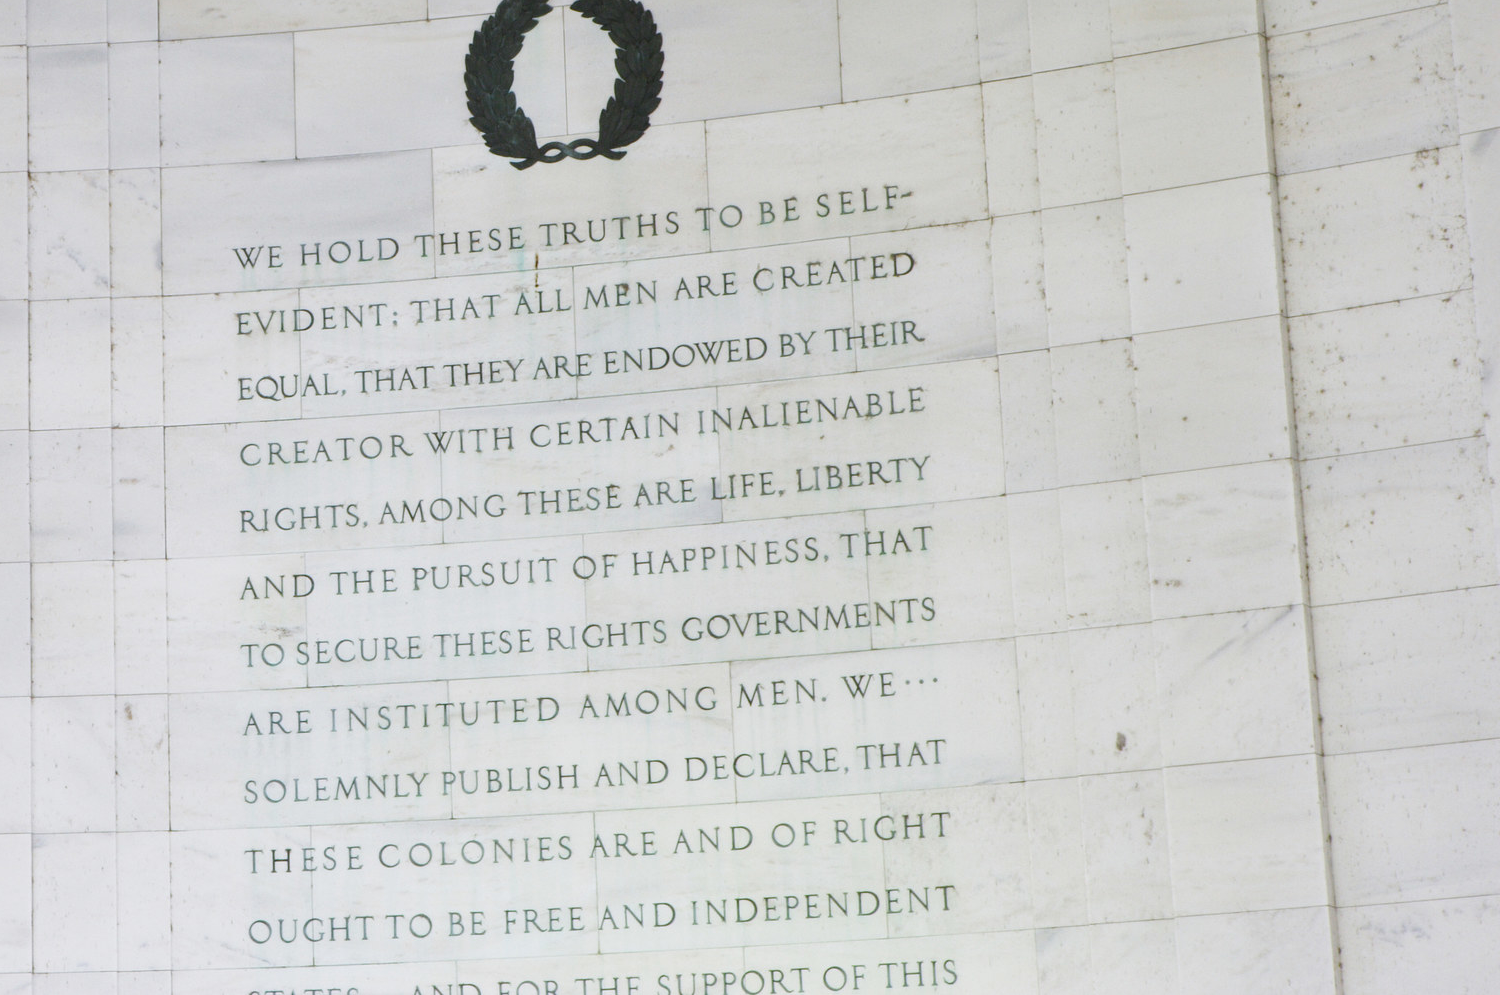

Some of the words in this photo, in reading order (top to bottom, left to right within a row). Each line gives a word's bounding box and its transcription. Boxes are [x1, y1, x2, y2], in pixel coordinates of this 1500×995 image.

[232, 245, 283, 269] WE
[300, 238, 399, 266] HOLD
[414, 226, 525, 257] THESE
[539, 211, 679, 246] TRUTHS
[695, 205, 743, 234] TO
[758, 199, 800, 225] BE
[816, 184, 914, 218] SELF-
[234, 303, 398, 336] EVIDENT;
[409, 294, 501, 325] THAT
[514, 287, 572, 316] ALL
[583, 280, 657, 310] MEN
[674, 272, 738, 301] ARE
[753, 252, 917, 294] CREATED
[238, 371, 346, 401] EQUAL,
[354, 366, 435, 395] THAT
[443, 359, 521, 387] THEY
[533, 353, 593, 381] ARE
[604, 337, 767, 374] ENDOWED
[779, 331, 817, 357] BY
[824, 321, 925, 352] THEIR
[240, 432, 414, 466] CREATOR
[423, 427, 514, 456] WITH
[530, 412, 679, 448] CERTAIN
[698, 387, 925, 434] INALIENABLE
[239, 504, 368, 533] RIGHTS,
[378, 494, 507, 525] AMONG
[517, 483, 622, 515] THESE
[634, 479, 697, 506] ARE
[711, 472, 786, 502] LIFE,
[796, 455, 931, 493] LIBERTY
[240, 574, 315, 600] AND
[329, 569, 398, 595] THE
[412, 557, 557, 591] PURSUIT
[573, 554, 618, 583] OF
[632, 537, 829, 576] HAPPINESS,
[839, 526, 933, 558] THAT
[240, 641, 284, 667] TO
[297, 636, 423, 665] SECURE
[432, 629, 534, 657] THESE
[546, 620, 667, 651] RIGHTS
[681, 597, 936, 643] GOVERNMENTS
[243, 710, 312, 736] ARE
[331, 697, 559, 732] INSTITUTED
[579, 686, 717, 719] AMONG
[737, 678, 826, 708] MEN.
[244, 773, 429, 804] SOLEMNLY
[441, 764, 579, 796] PUBLISH
[594, 760, 669, 787] AND
[684, 747, 849, 783] DECLARE,
[856, 739, 946, 770] THAT
[244, 845, 363, 874] THESE
[379, 836, 572, 868] COLONIES
[589, 831, 657, 858] ARE
[673, 826, 753, 854] AND
[771, 821, 819, 848] OF
[833, 812, 951, 844] RIGHT
[248, 915, 374, 944] OUGHT
[385, 913, 432, 939] TO
[448, 911, 486, 936] BE
[504, 907, 585, 934] FREE
[598, 903, 676, 930] AND
[691, 885, 956, 925] INDEPENDENT
[574, 976, 640, 995] THE
[658, 968, 810, 995] SUPPORT
[823, 965, 865, 991] OF
[878, 959, 958, 991] THIS
